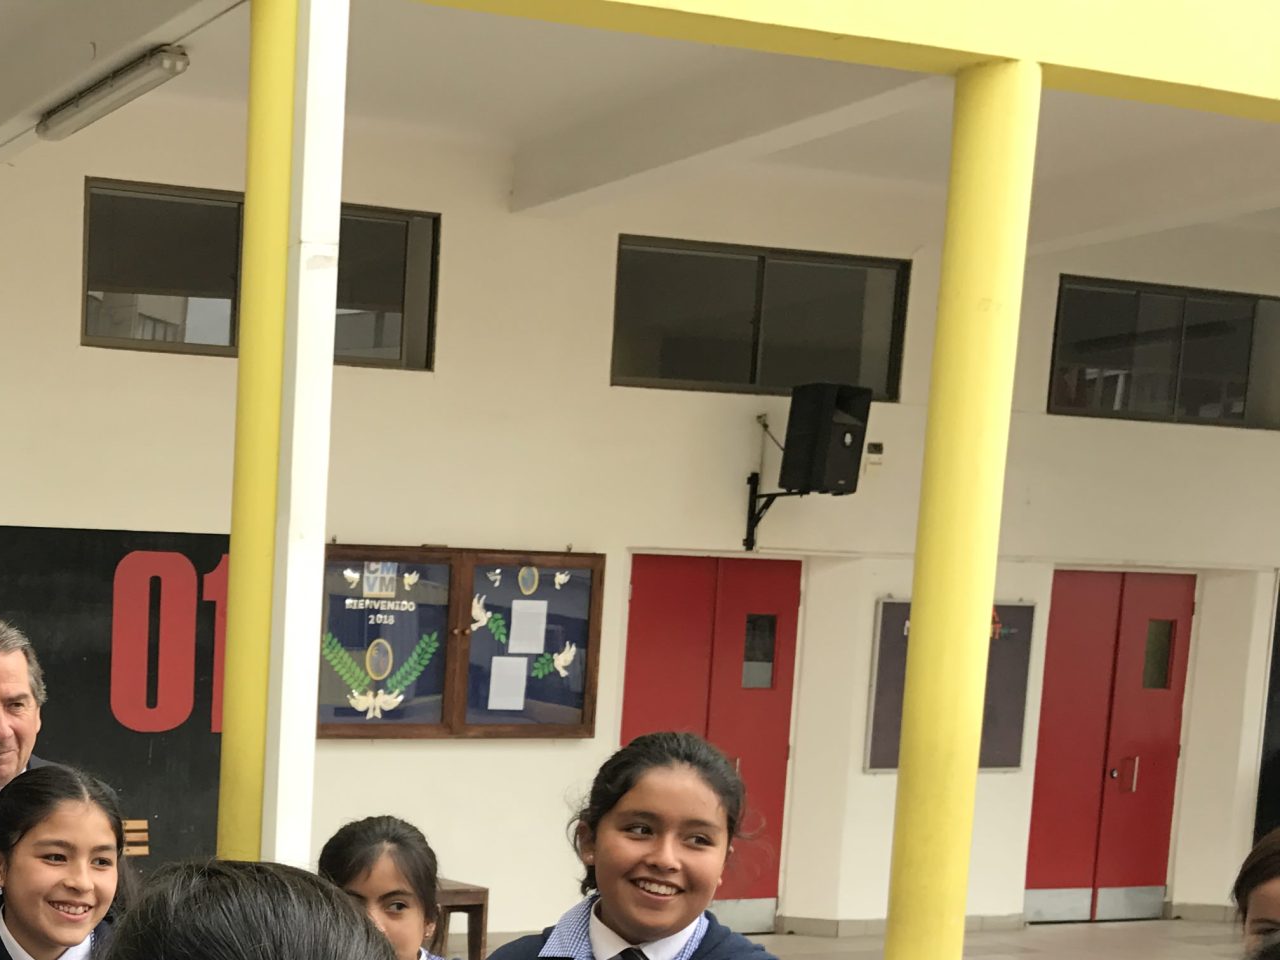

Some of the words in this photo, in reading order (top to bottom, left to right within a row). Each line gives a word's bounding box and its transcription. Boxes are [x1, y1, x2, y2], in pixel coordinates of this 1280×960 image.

[365, 576, 396, 592] VM
[345, 598, 416, 611] BIENVENIDO
[368, 614, 395, 625] 2018
